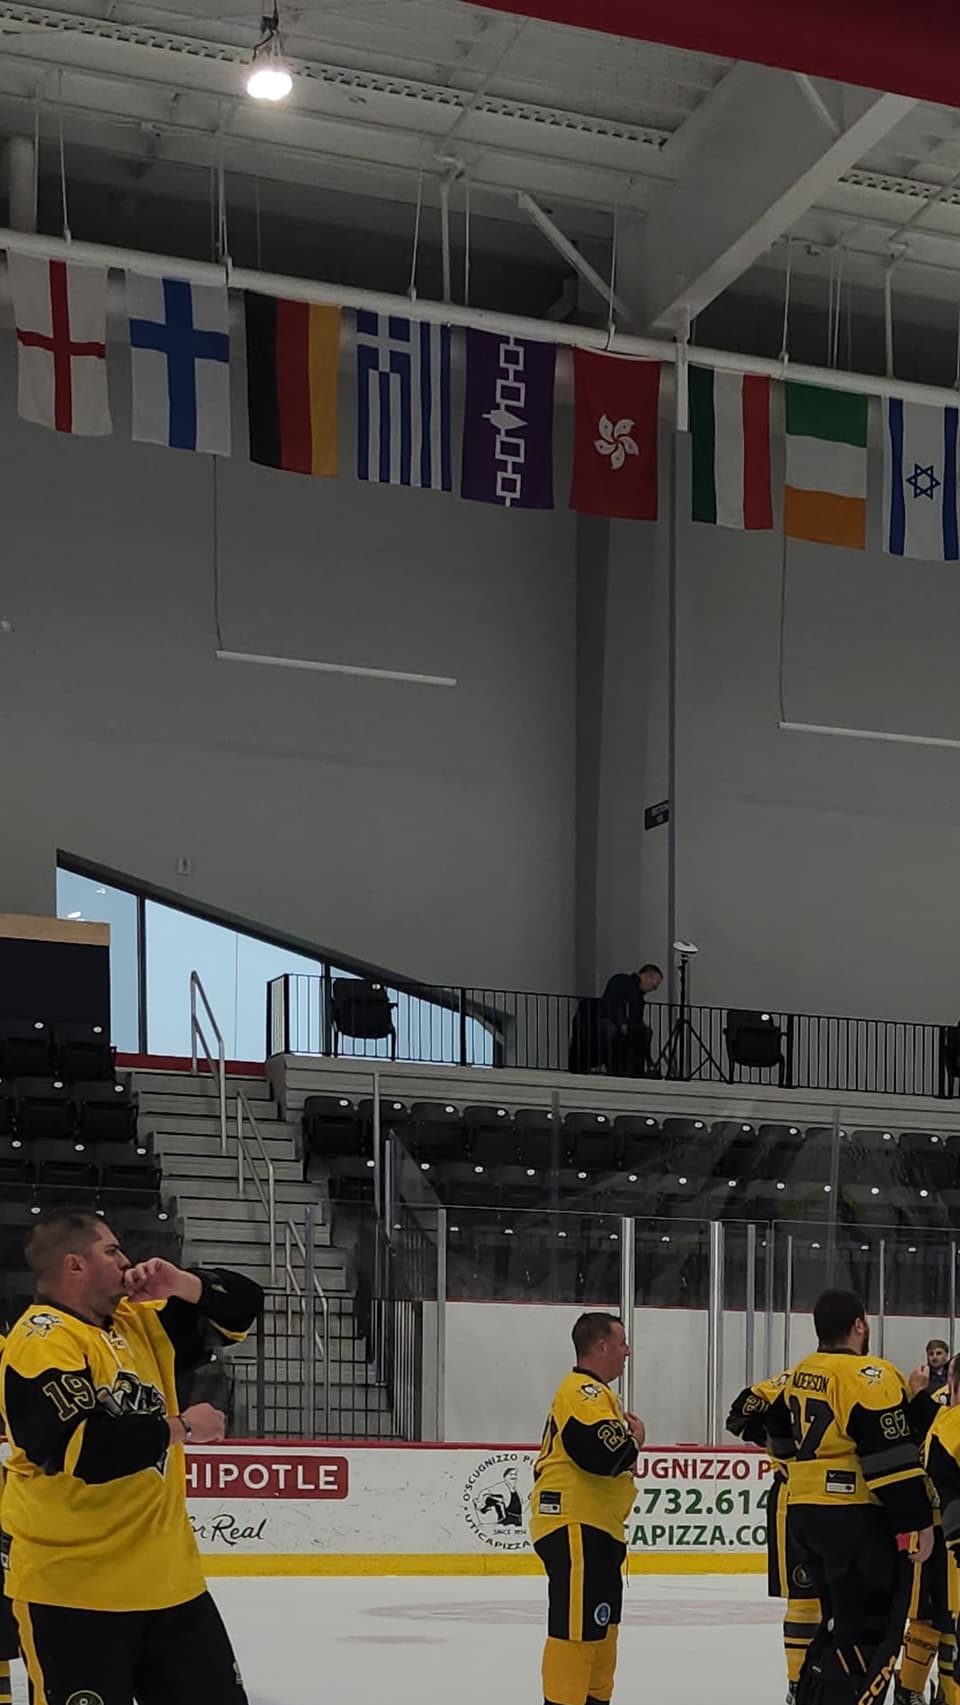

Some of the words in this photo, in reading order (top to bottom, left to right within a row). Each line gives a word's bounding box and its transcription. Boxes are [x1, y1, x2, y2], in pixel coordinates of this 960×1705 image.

[42, 1374, 96, 1422] 19
[880, 1409, 911, 1440] 97
[185, 1463, 338, 1490] HIPOTLE
[633, 1458, 750, 1480] UGNIZZO
[633, 1488, 770, 1515] .732.614
[212, 1513, 267, 1546] Real
[625, 1524, 769, 1546] APIZZA.CO
